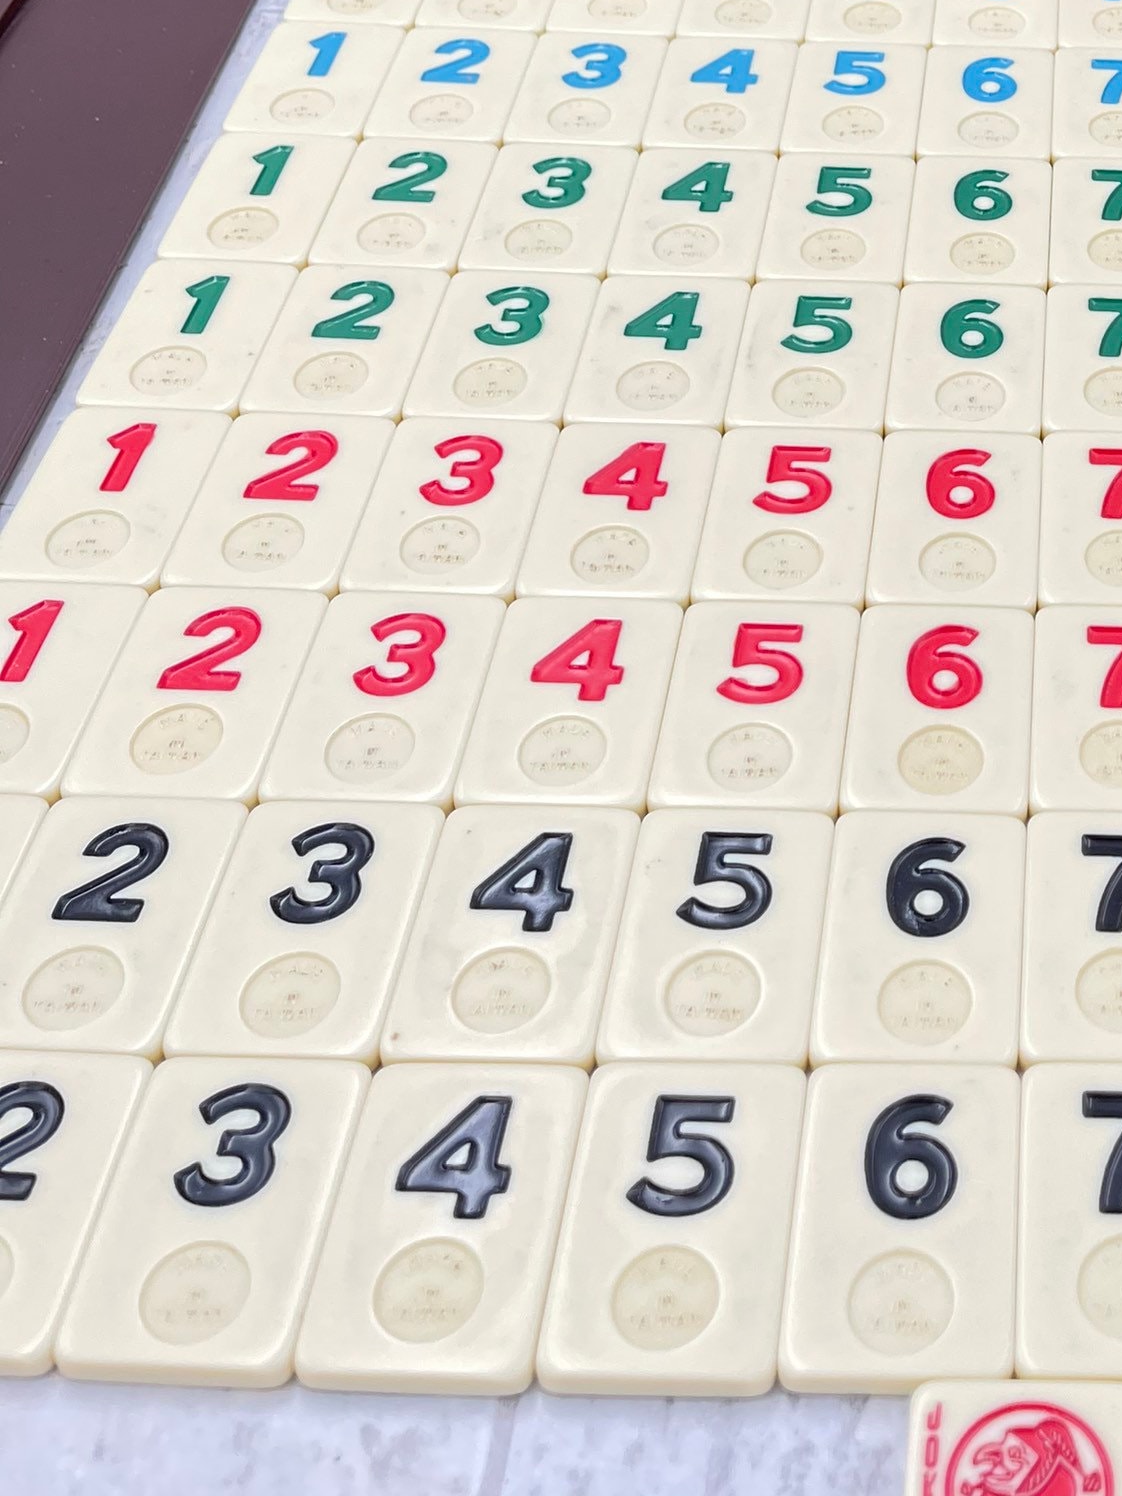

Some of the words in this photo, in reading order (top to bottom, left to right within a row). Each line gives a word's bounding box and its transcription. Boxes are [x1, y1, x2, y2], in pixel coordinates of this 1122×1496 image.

[307, 31, 346, 78] 1
[420, 38, 491, 85] 2
[561, 42, 628, 90] 3
[689, 48, 759, 95] 4
[823, 49, 887, 97] 5
[961, 56, 1019, 104] 6
[249, 144, 293, 197] 1
[371, 150, 449, 204] 2
[521, 156, 593, 210] 3
[660, 160, 734, 214] 4
[804, 165, 874, 218] 5
[952, 168, 1014, 222] 6
[179, 275, 231, 335] 1
[310, 280, 396, 341] 2
[473, 285, 551, 347] 3
[622, 290, 703, 352] 4
[780, 294, 854, 355] 5
[939, 298, 1005, 360] 6
[98, 422, 158, 494] 1
[241, 429, 340, 503] 2
[418, 434, 505, 508] 3
[581, 440, 670, 513] 4
[751, 444, 834, 516] 5
[924, 447, 997, 521] 6
[0, 598, 66, 684] 1
[155, 605, 263, 693] 2
[351, 611, 448, 698] 3
[529, 617, 626, 703] 4
[715, 621, 805, 706] 5
[904, 623, 985, 711] 6
[50, 821, 171, 924] 2
[268, 821, 376, 926] 3
[468, 831, 575, 934] 4
[674, 830, 775, 932] 5
[884, 836, 971, 939] 6
[0, 1079, 66, 1203] 2
[172, 1082, 293, 1209] 3
[393, 1094, 514, 1221] 4
[624, 1093, 737, 1219] 5
[863, 1093, 959, 1222] 6
